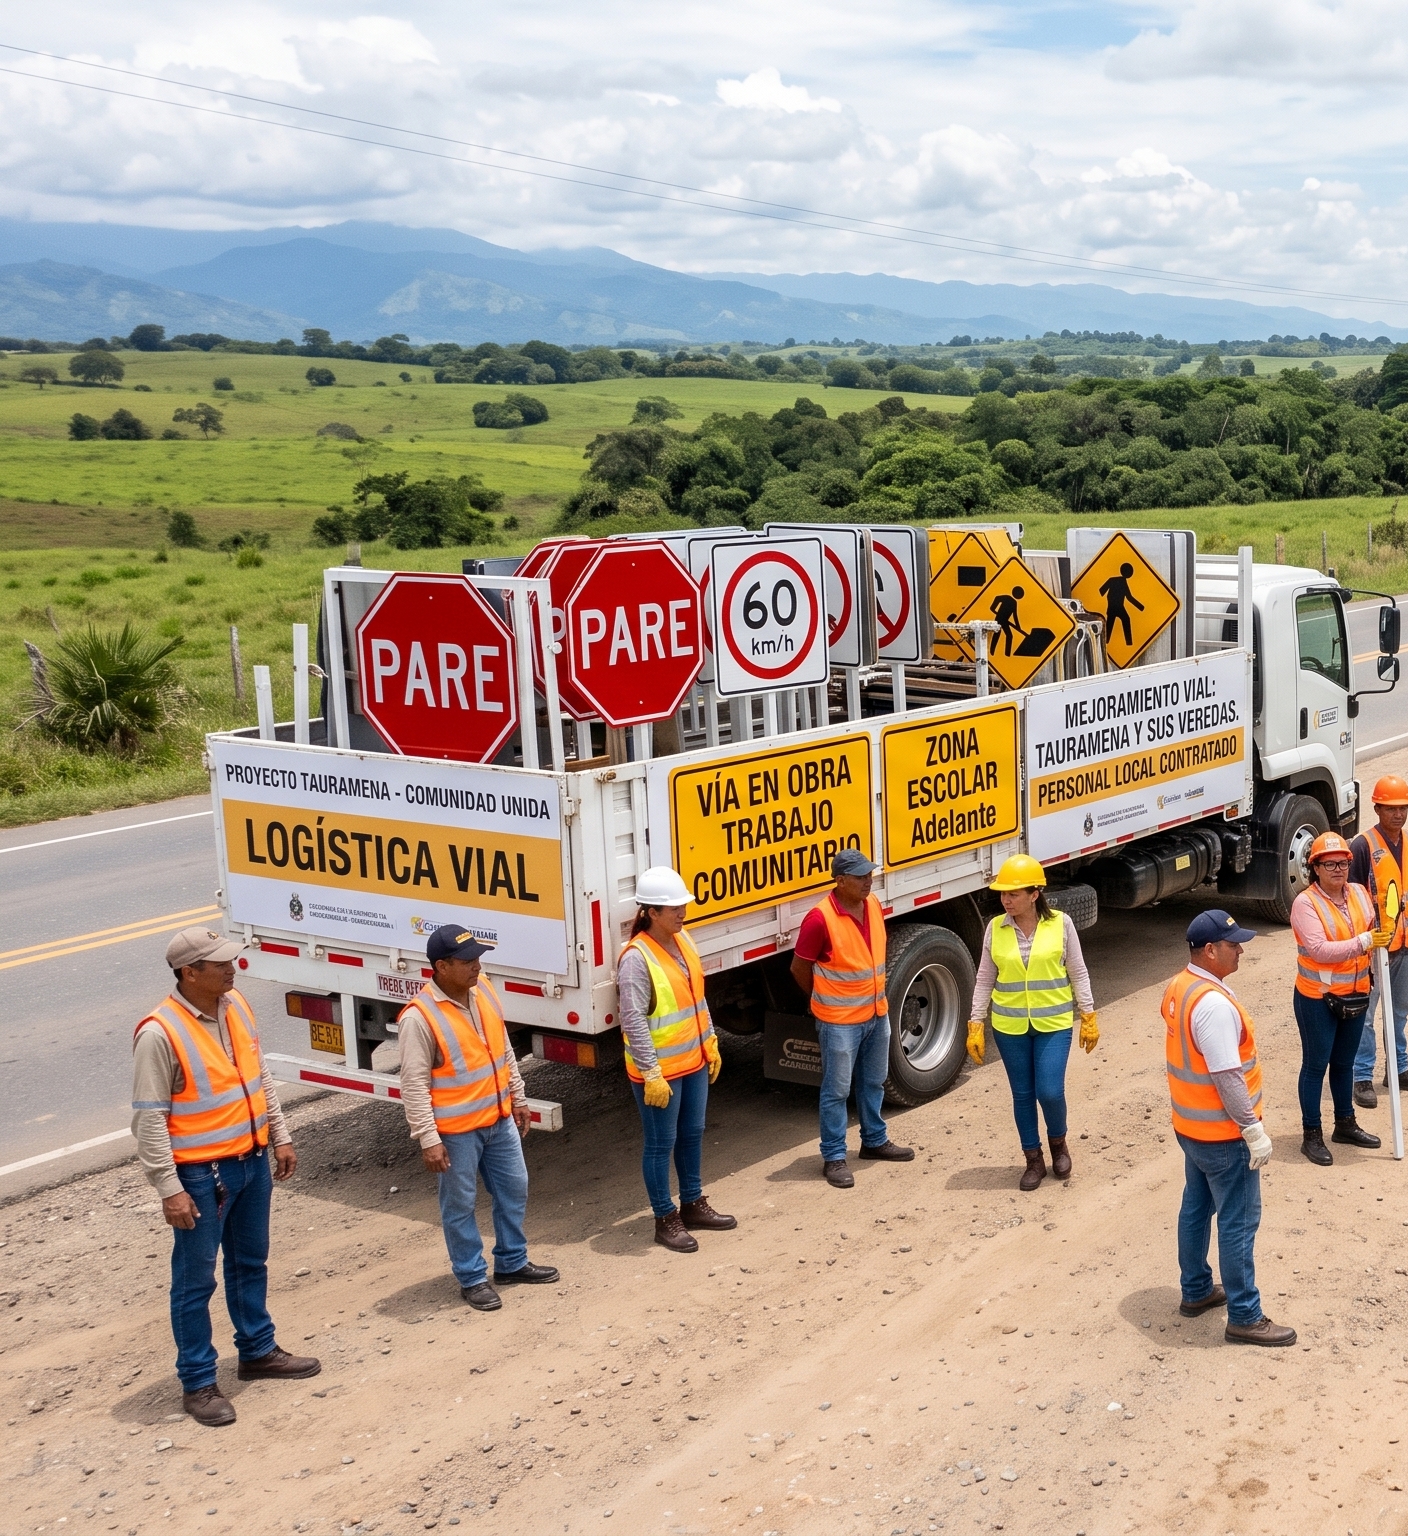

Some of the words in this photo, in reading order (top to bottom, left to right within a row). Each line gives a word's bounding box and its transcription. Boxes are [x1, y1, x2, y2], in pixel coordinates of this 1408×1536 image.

[743, 579, 797, 630] 60
[579, 598, 694, 670] PARE
[751, 634, 795, 656] km/h
[371, 638, 504, 713] PARE
[1065, 682, 1180, 730] MEJORAMIENTO
[1183, 675, 1216, 703] VIAL:
[926, 727, 980, 766] ZONA
[1035, 725, 1131, 770] TAURAMENA
[1133, 720, 1144, 746] Y
[1147, 713, 1176, 743] SUS
[1178, 700, 1239, 736] VEREDAS.
[225, 763, 297, 790] PROYECTO
[300, 772, 391, 801] TAURAMENA
[405, 784, 497, 813] COMUNIDAD
[501, 794, 551, 820] UNIDA
[696, 771, 741, 818] VÍA
[748, 769, 780, 807] EN
[787, 755, 853, 798] OBRA
[907, 760, 999, 811] ESCOLAR
[1038, 768, 1111, 807] PERSONAL
[1115, 757, 1157, 787] LOCAL
[1159, 735, 1237, 775] CONTRATADO
[721, 798, 833, 856] TRABAJO
[910, 802, 998, 849] Adelante
[245, 816, 440, 889] LOGÍSTICA
[447, 844, 540, 903] VIAL
